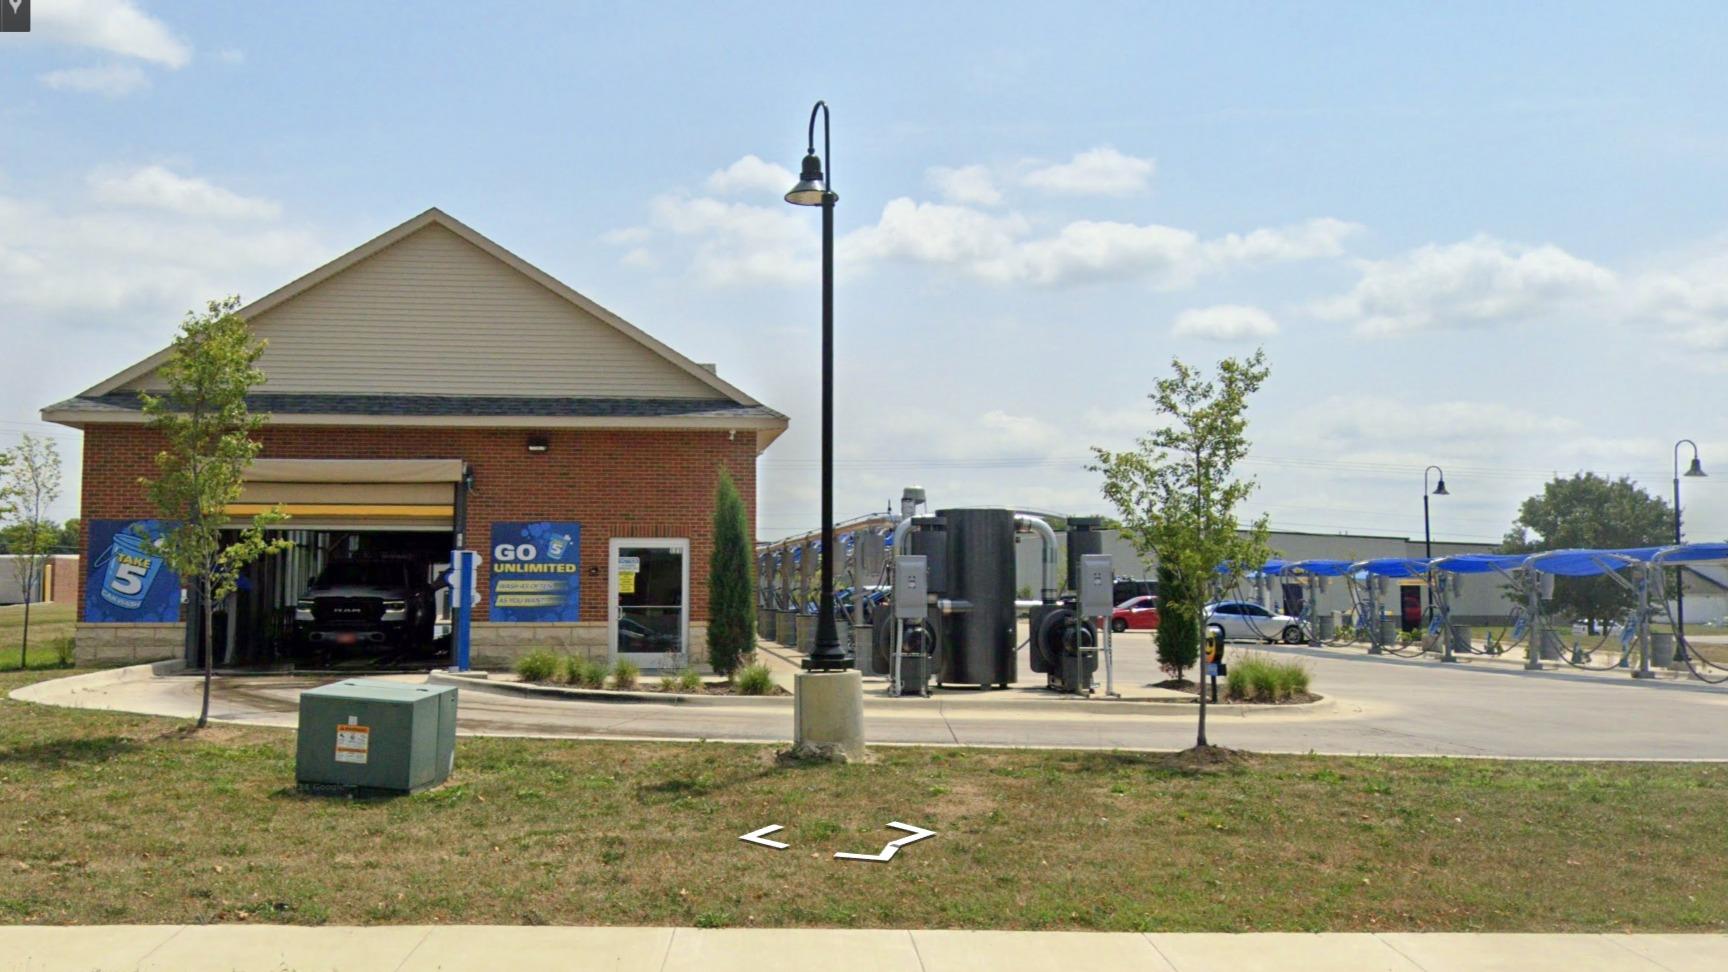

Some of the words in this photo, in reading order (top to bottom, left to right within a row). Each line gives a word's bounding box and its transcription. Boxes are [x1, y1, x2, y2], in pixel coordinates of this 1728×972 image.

[494, 544, 536, 560] GO
[118, 553, 151, 569] TAKE
[494, 564, 576, 572] UNLIMITED
[111, 563, 147, 595] 5
